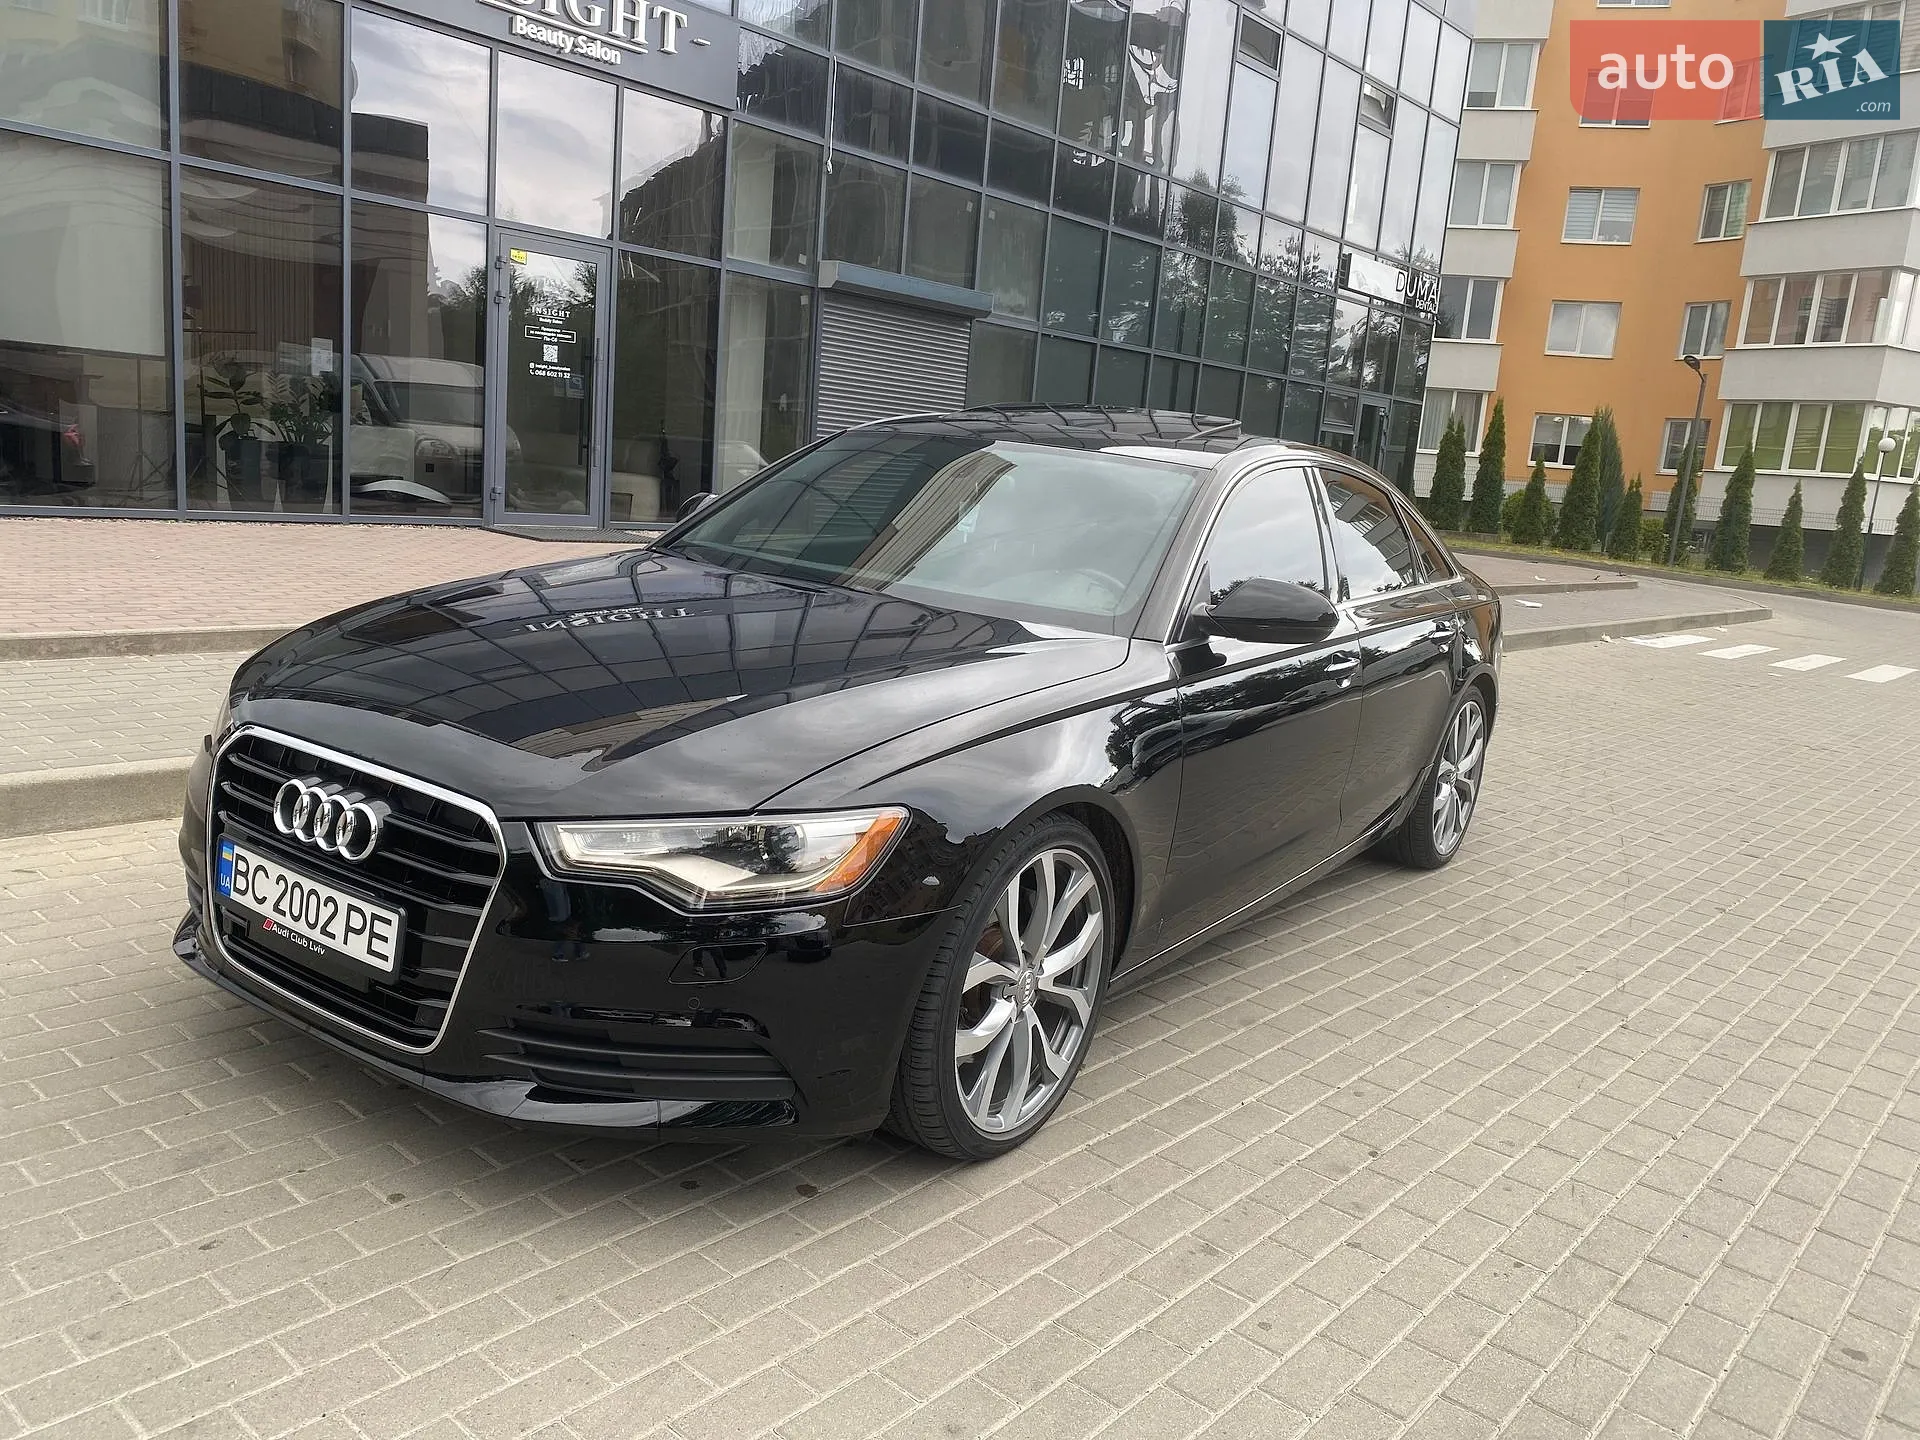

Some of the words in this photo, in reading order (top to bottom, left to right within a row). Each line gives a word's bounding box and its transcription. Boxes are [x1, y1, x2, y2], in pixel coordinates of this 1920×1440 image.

[514, 15, 574, 53] Beauty
[575, 36, 621, 65] Salon
[1396, 270, 1438, 304] DUMA
[531, 306, 570, 318] INSIGHT
[546, 370, 557, 378] 602
[220, 873, 231, 888] UA
[233, 853, 270, 905] BC
[272, 874, 339, 941] 2002
[343, 903, 392, 963] PE
[271, 924, 290, 939] Audi
[290, 932, 308, 947] Club
[309, 940, 326, 955] Lviv
